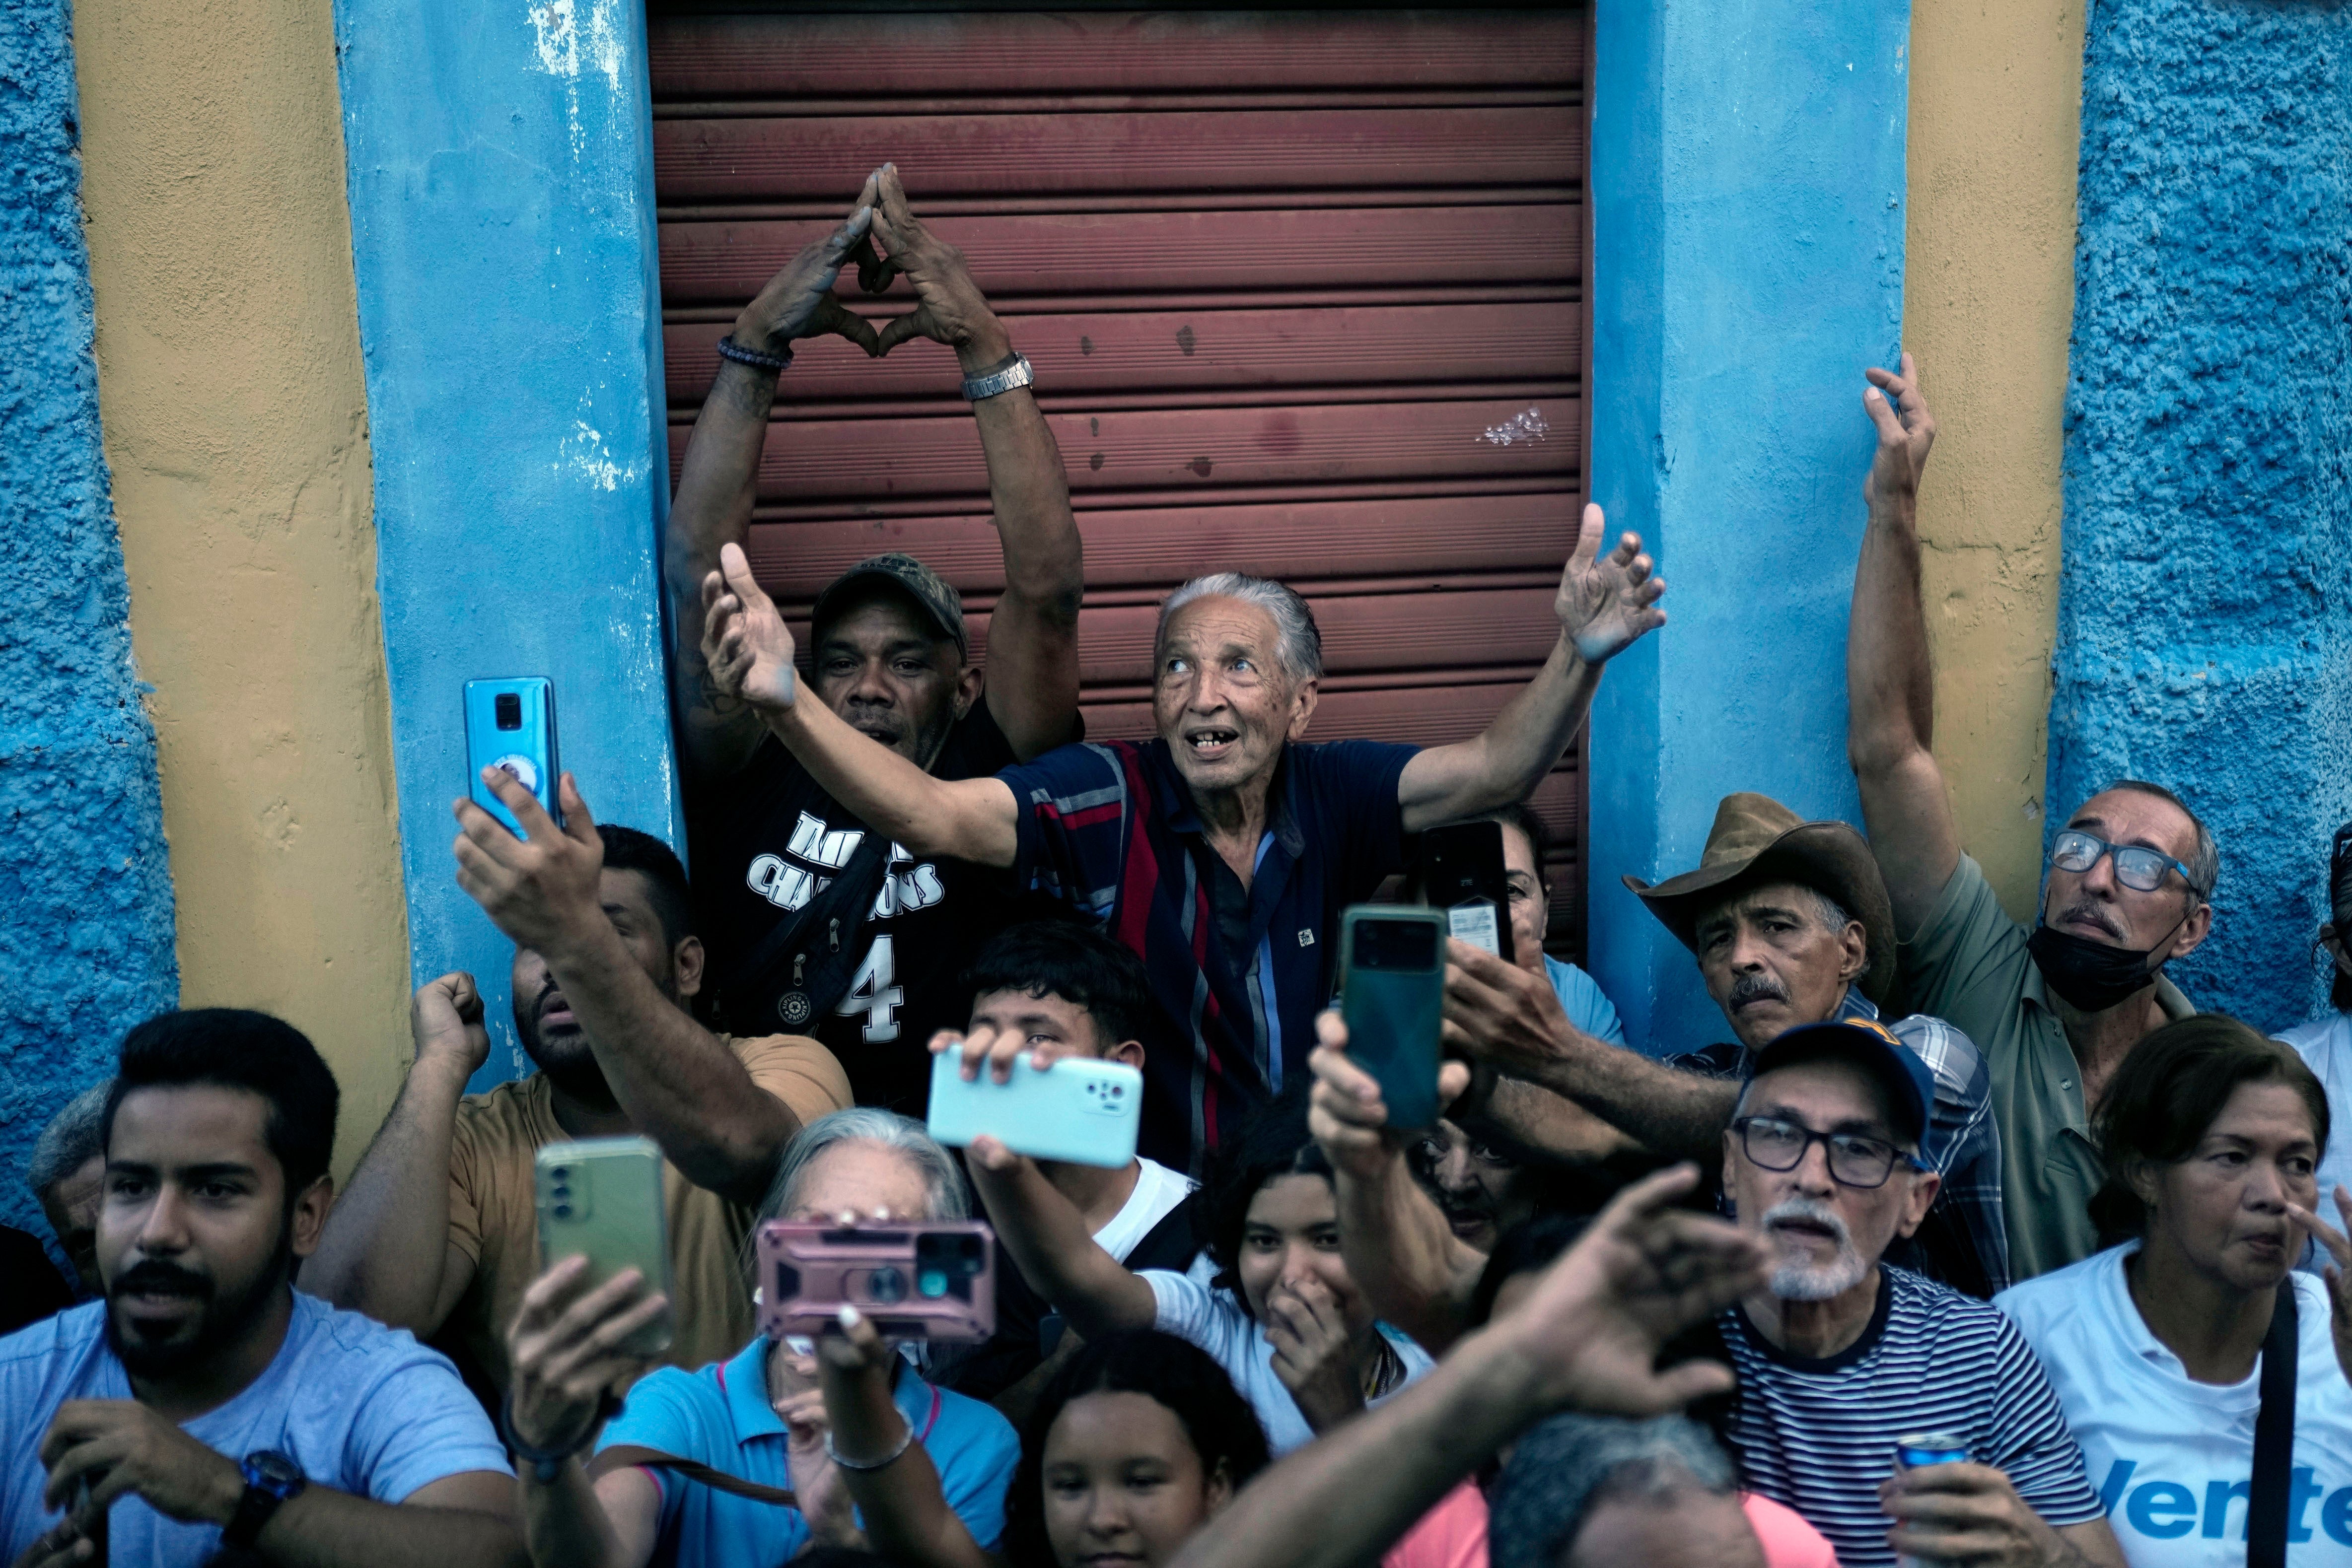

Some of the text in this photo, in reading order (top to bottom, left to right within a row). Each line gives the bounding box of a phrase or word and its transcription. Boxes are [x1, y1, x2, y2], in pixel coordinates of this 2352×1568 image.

[746, 853, 945, 922] CHAONS
[782, 995, 801, 1010] KIPLING
[833, 934, 904, 1043] 4
[788, 1006, 807, 1021] KIPLING
